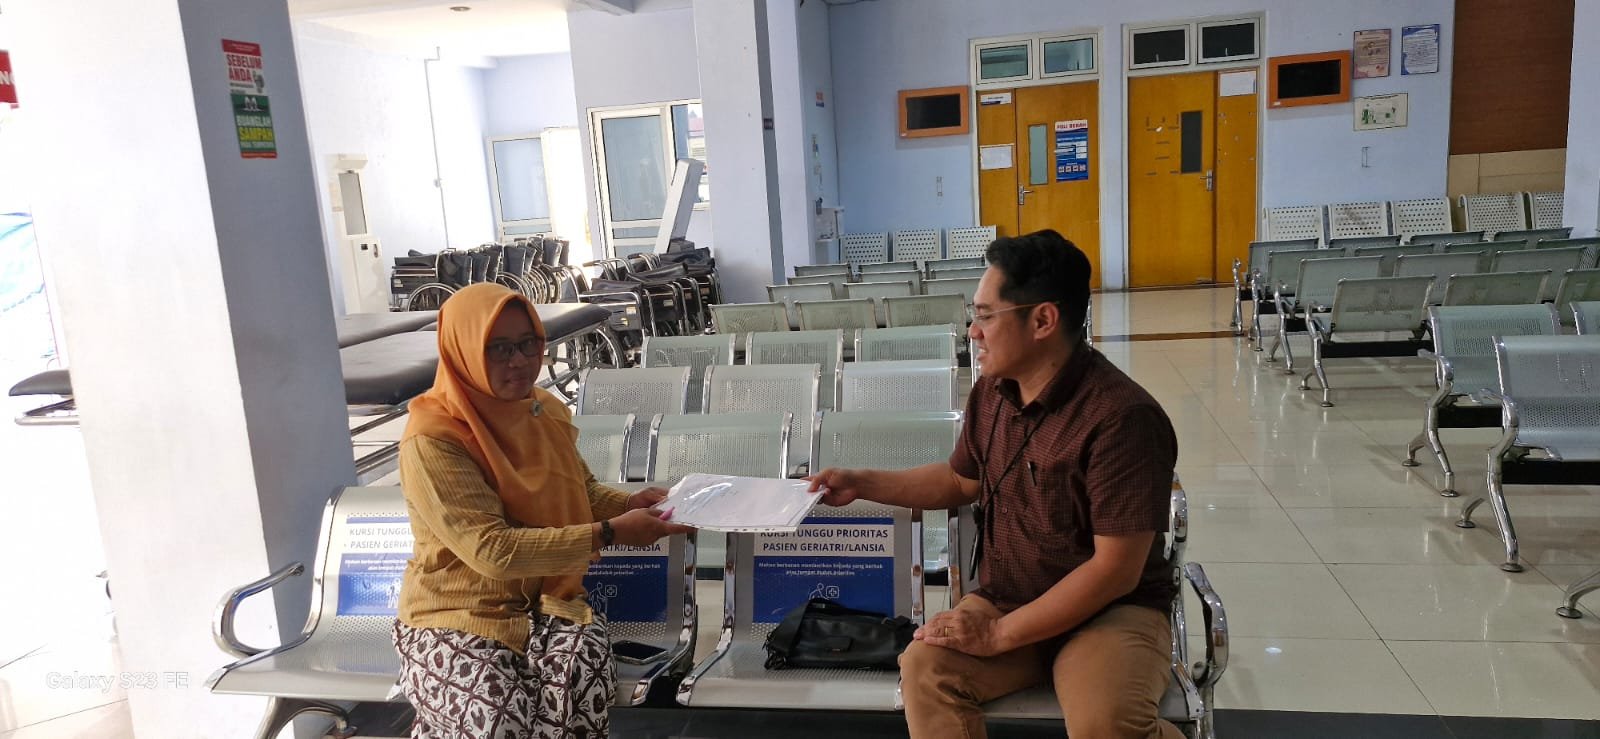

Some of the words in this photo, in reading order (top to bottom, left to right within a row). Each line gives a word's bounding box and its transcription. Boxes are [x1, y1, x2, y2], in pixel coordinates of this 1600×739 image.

[226, 53, 263, 69] SEBELUM
[228, 67, 252, 82] ANDA
[239, 127, 273, 141] SAMPAH
[349, 527, 375, 536] KURSI
[836, 529, 889, 538] PRIORITAS
[350, 540, 381, 549] PASIEN
[763, 543, 798, 552] PASIEN
[800, 543, 886, 553] GERIATRI/LANSIA
